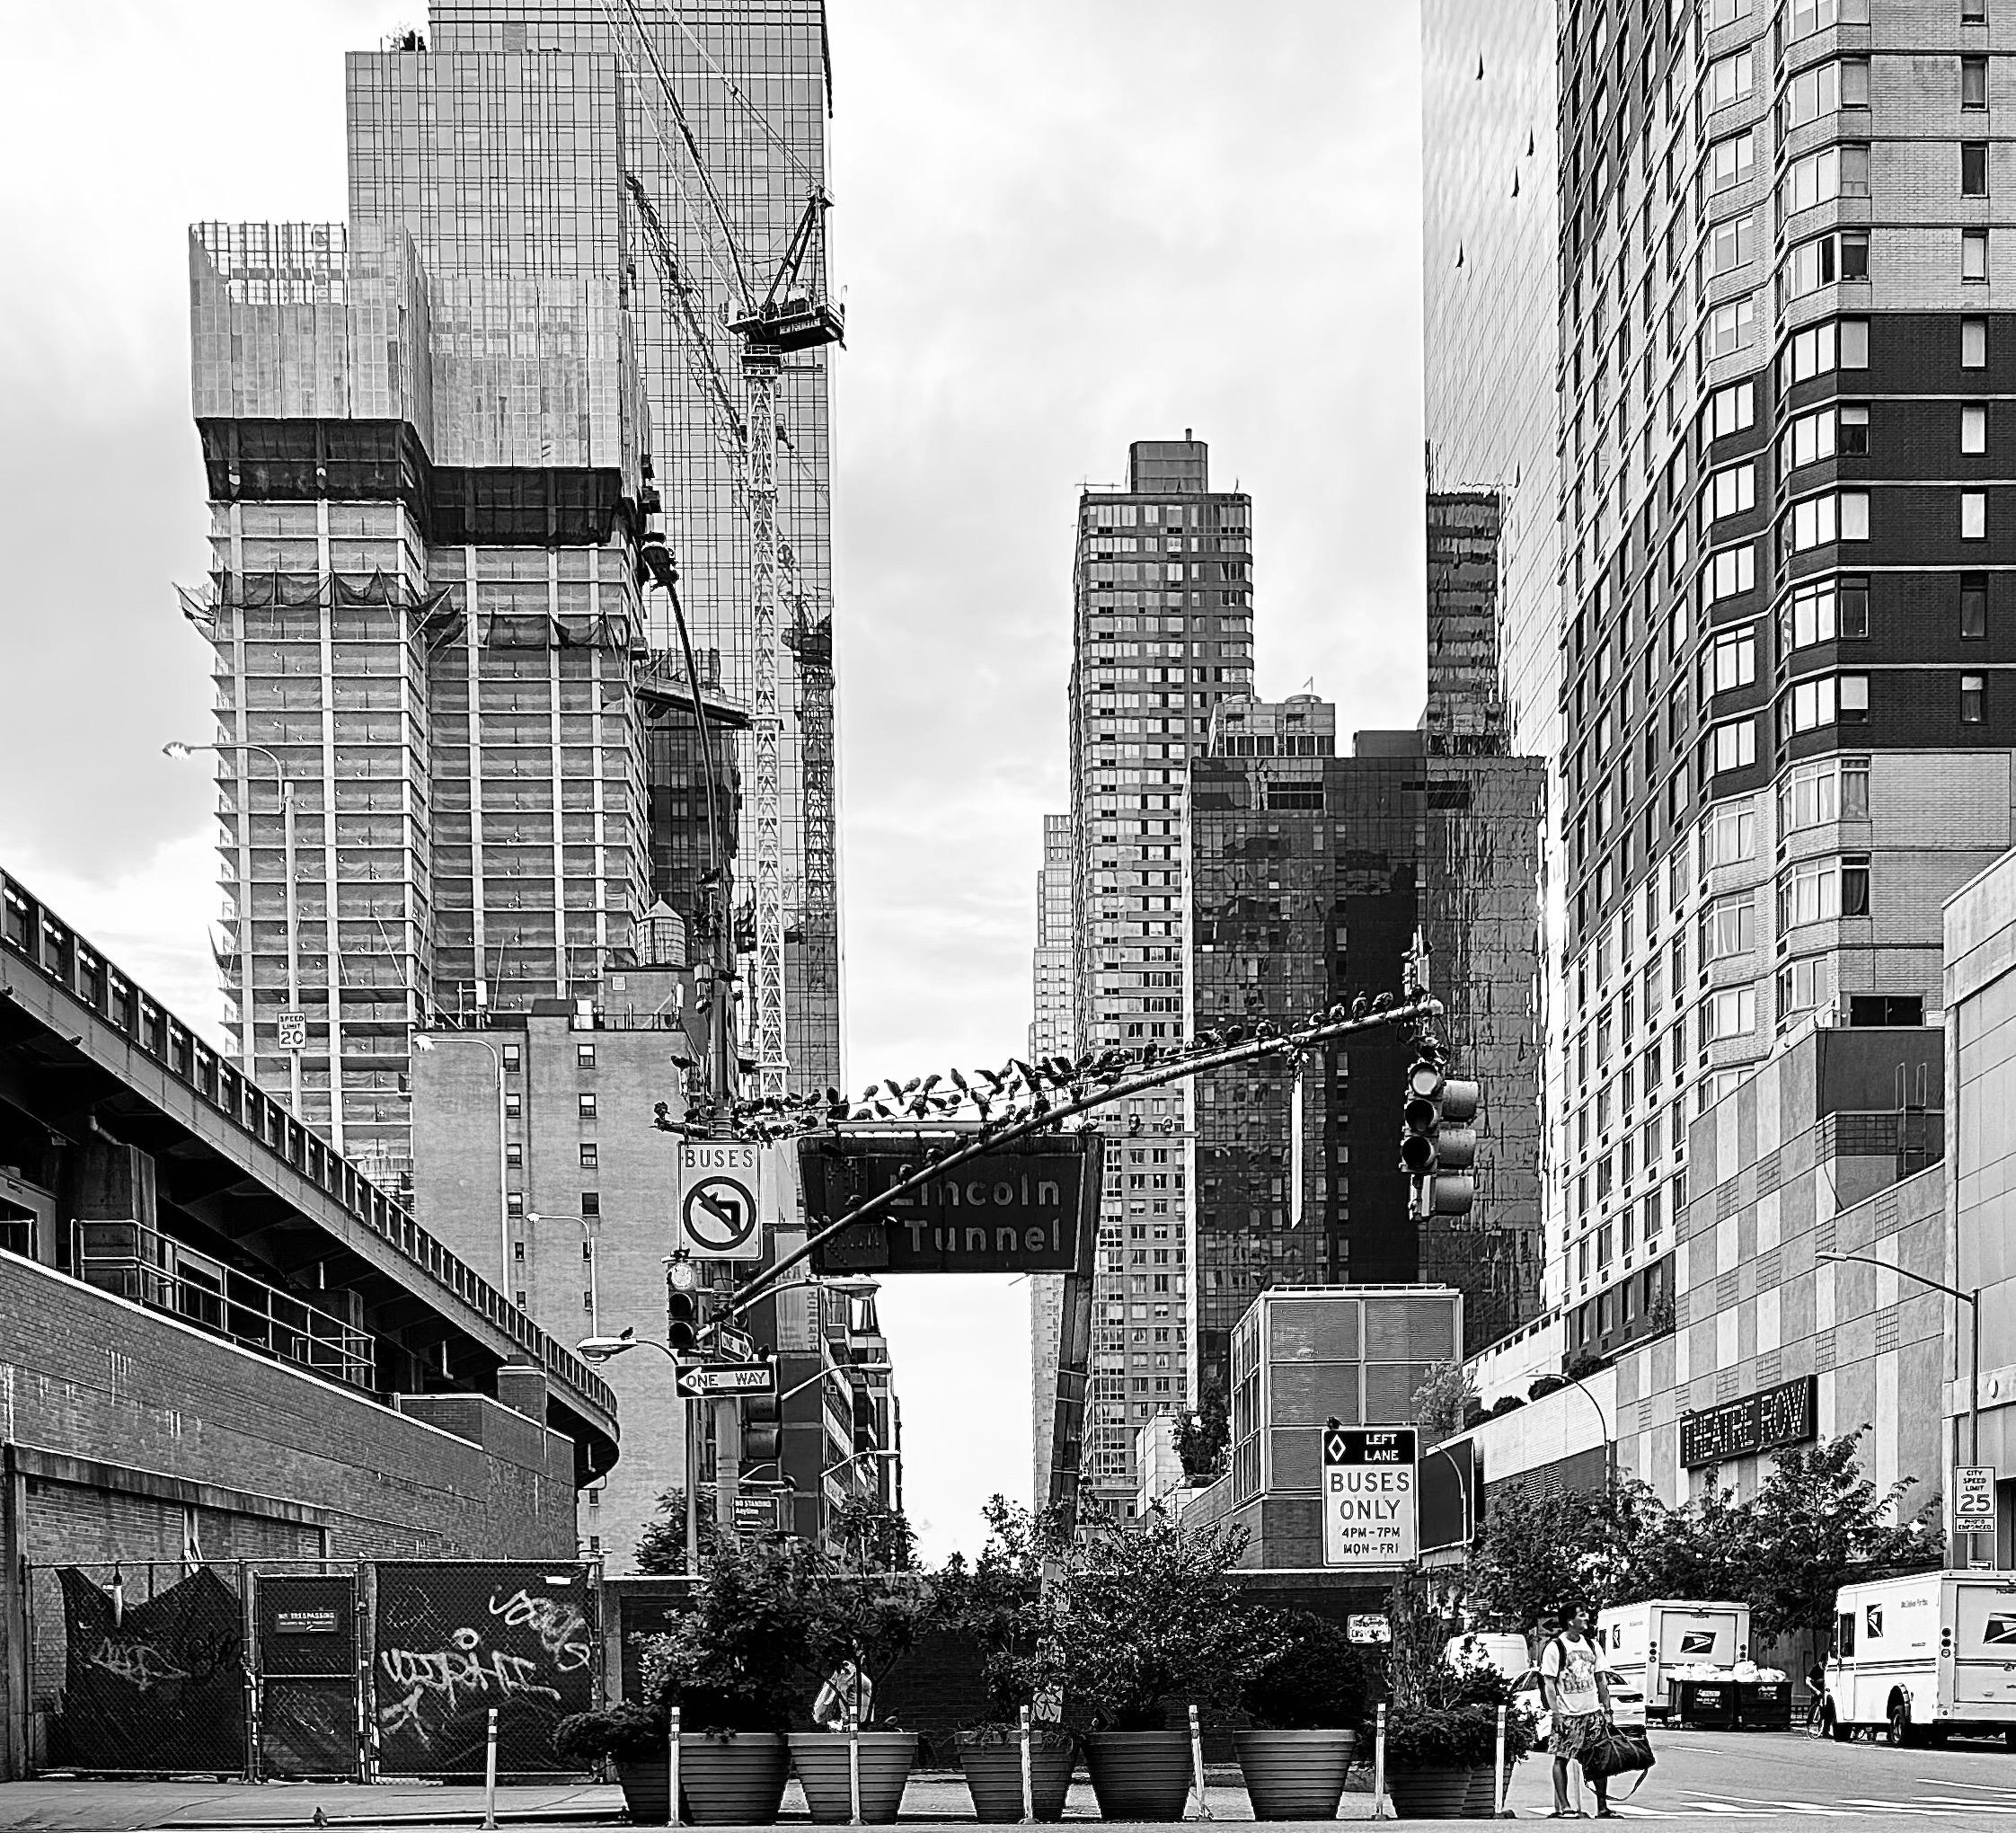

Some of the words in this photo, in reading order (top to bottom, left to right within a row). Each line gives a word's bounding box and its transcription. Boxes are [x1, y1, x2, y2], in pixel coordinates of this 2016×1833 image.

[280, 1031, 304, 1045] 20
[685, 1149, 753, 1168] BUSES
[889, 1172, 1060, 1206] Lincoln
[904, 1218, 1059, 1252] Tunnel
[722, 1334, 734, 1350] ONE
[685, 1374, 719, 1387] ONE
[735, 1371, 765, 1386] WAY
[1681, 1399, 1755, 1462] THEATRE
[1761, 1382, 1807, 1443] ROW
[1366, 1433, 1398, 1445] LEFT
[1364, 1449, 1399, 1461] LANE
[1331, 1472, 1410, 1492] BUSES
[1340, 1499, 1401, 1519] ONLY
[1960, 1493, 1991, 1511] 25
